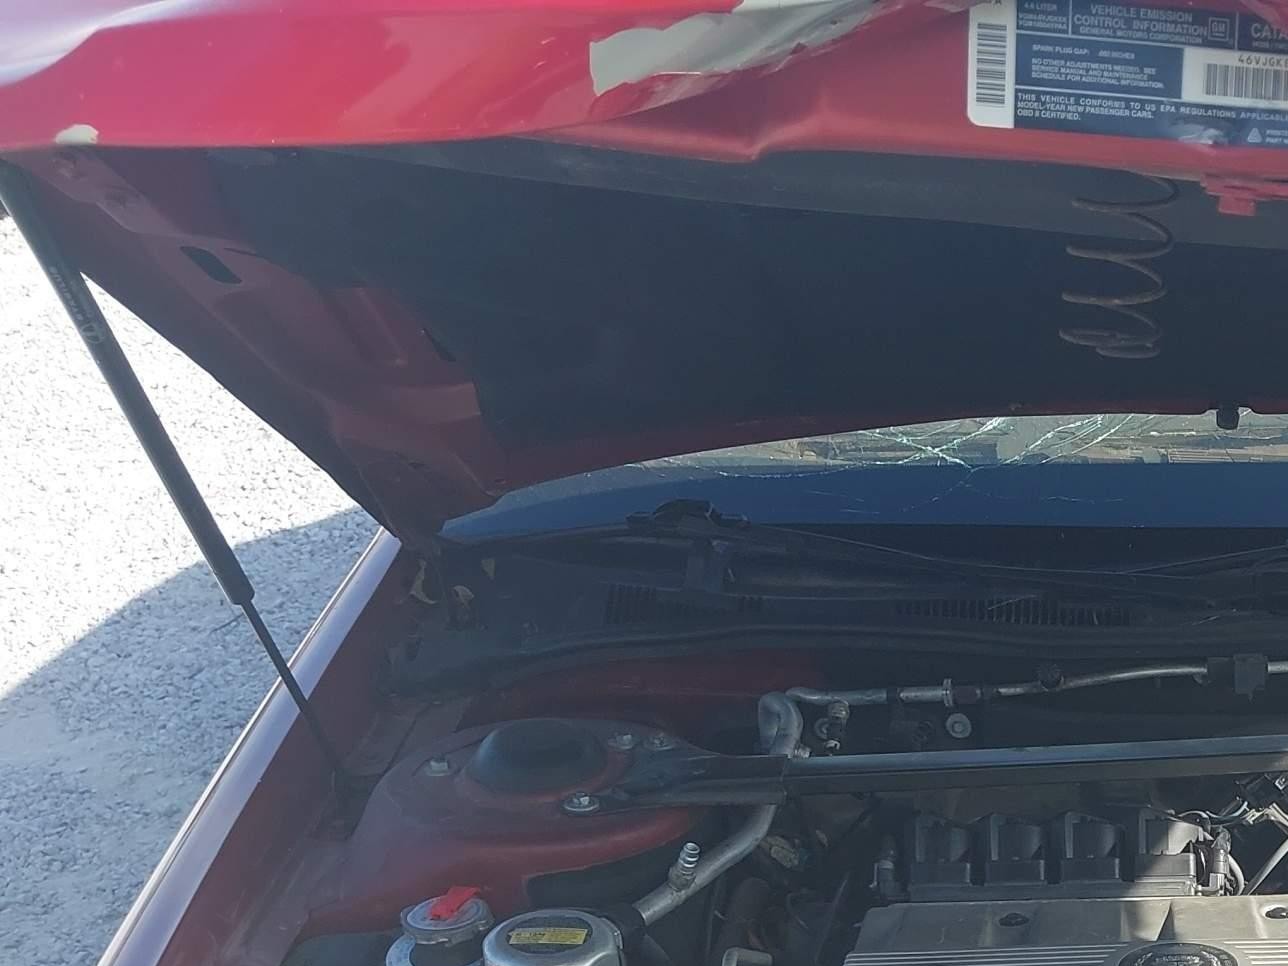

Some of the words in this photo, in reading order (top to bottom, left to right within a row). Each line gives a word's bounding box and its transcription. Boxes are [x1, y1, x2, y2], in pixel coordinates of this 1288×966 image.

[1090, 4, 1137, 17] VEHICLE
[1139, 7, 1193, 22] EMISSION
[1074, 14, 1128, 29] CONTROL
[1132, 19, 1208, 36] INFORMATION
[1079, 26, 1113, 36] GENERAL
[1115, 29, 1148, 39] MOTORS
[1149, 32, 1203, 44] CORPORATION
[1055, 46, 1073, 54] PLUG
[1017, 92, 1036, 101] THIS
[1040, 94, 1075, 104] VEHICLE
[1079, 97, 1127, 109] CONFORMS
[1129, 102, 1141, 110] TO
[1159, 104, 1176, 112] EPA
[1179, 105, 1236, 118] REGULATIONS
[1017, 108, 1034, 117] OBD
[1066, 104, 1085, 113] NEW
[1085, 105, 1131, 117] PASSENGER
